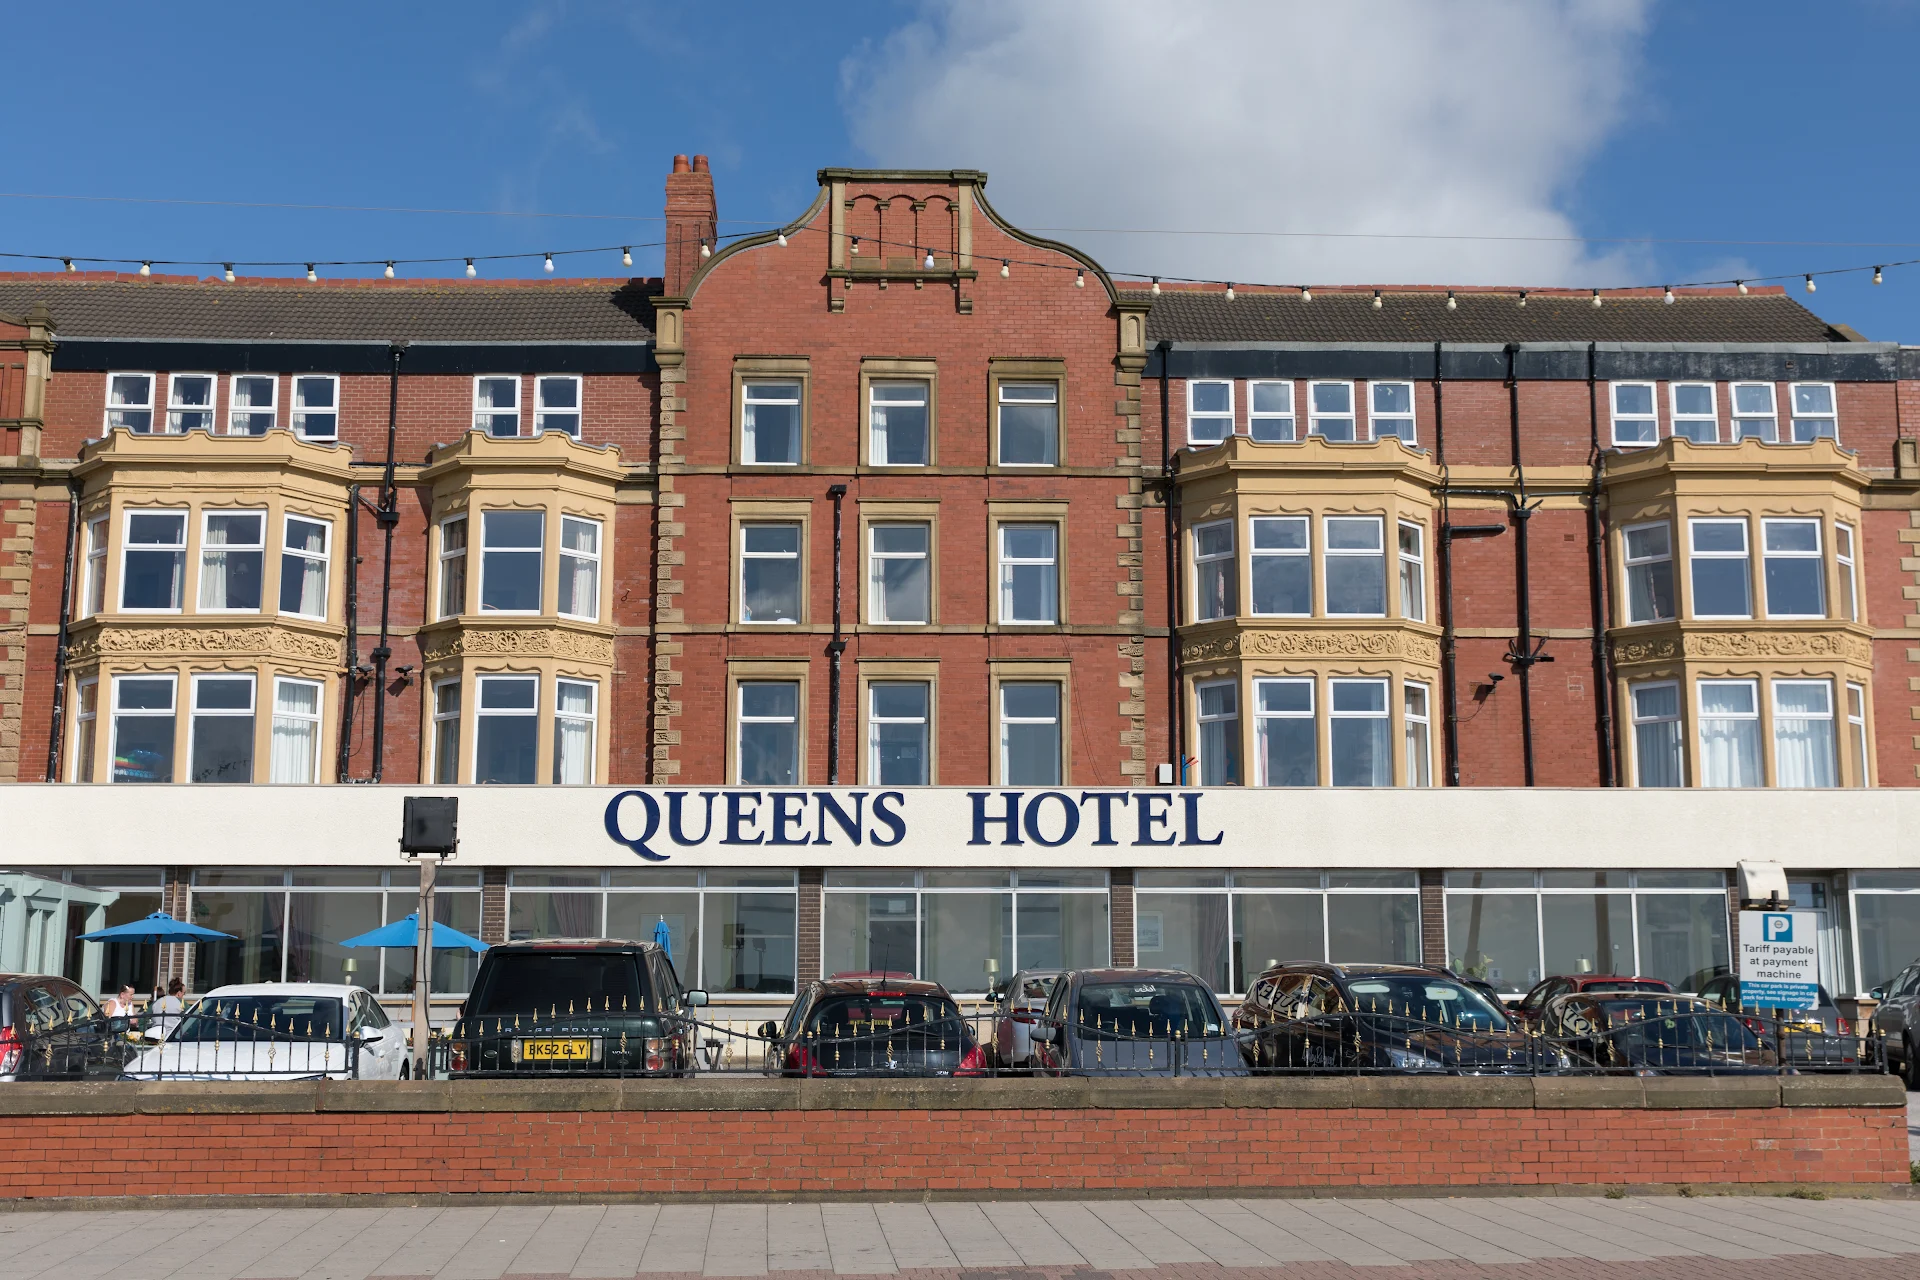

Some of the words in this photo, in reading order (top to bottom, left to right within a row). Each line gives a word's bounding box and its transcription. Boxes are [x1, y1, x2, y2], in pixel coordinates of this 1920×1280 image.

[604, 789, 907, 861] QUEENS
[966, 791, 1225, 846] HOTEL
[1767, 916, 1790, 940] P
[1743, 944, 1770, 953] Tariff
[1773, 946, 1814, 956] payable
[1750, 957, 1760, 965] at
[1763, 958, 1808, 968] payment
[1757, 970, 1802, 979] machine
[529, 1044, 559, 1055] BK52
